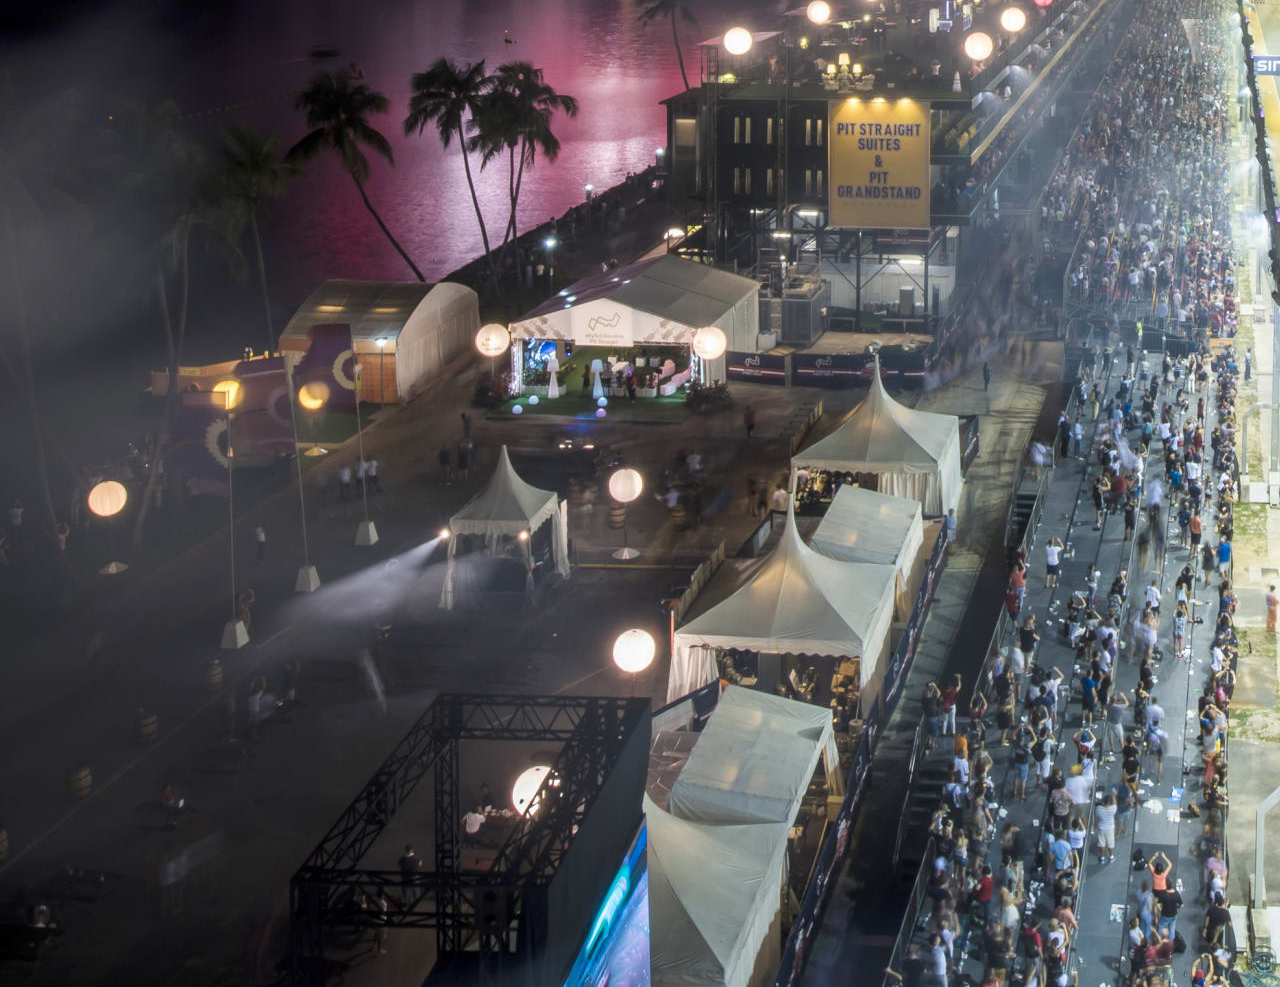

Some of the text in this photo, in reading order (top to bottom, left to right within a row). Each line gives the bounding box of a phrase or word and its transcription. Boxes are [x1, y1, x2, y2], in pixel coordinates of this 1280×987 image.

[837, 123, 921, 136] PIT STRAIGHT
[858, 138, 901, 151] SUITES
[875, 155, 882, 167] &
[869, 171, 889, 184] PIT
[837, 185, 921, 199] GRANDSTAND
